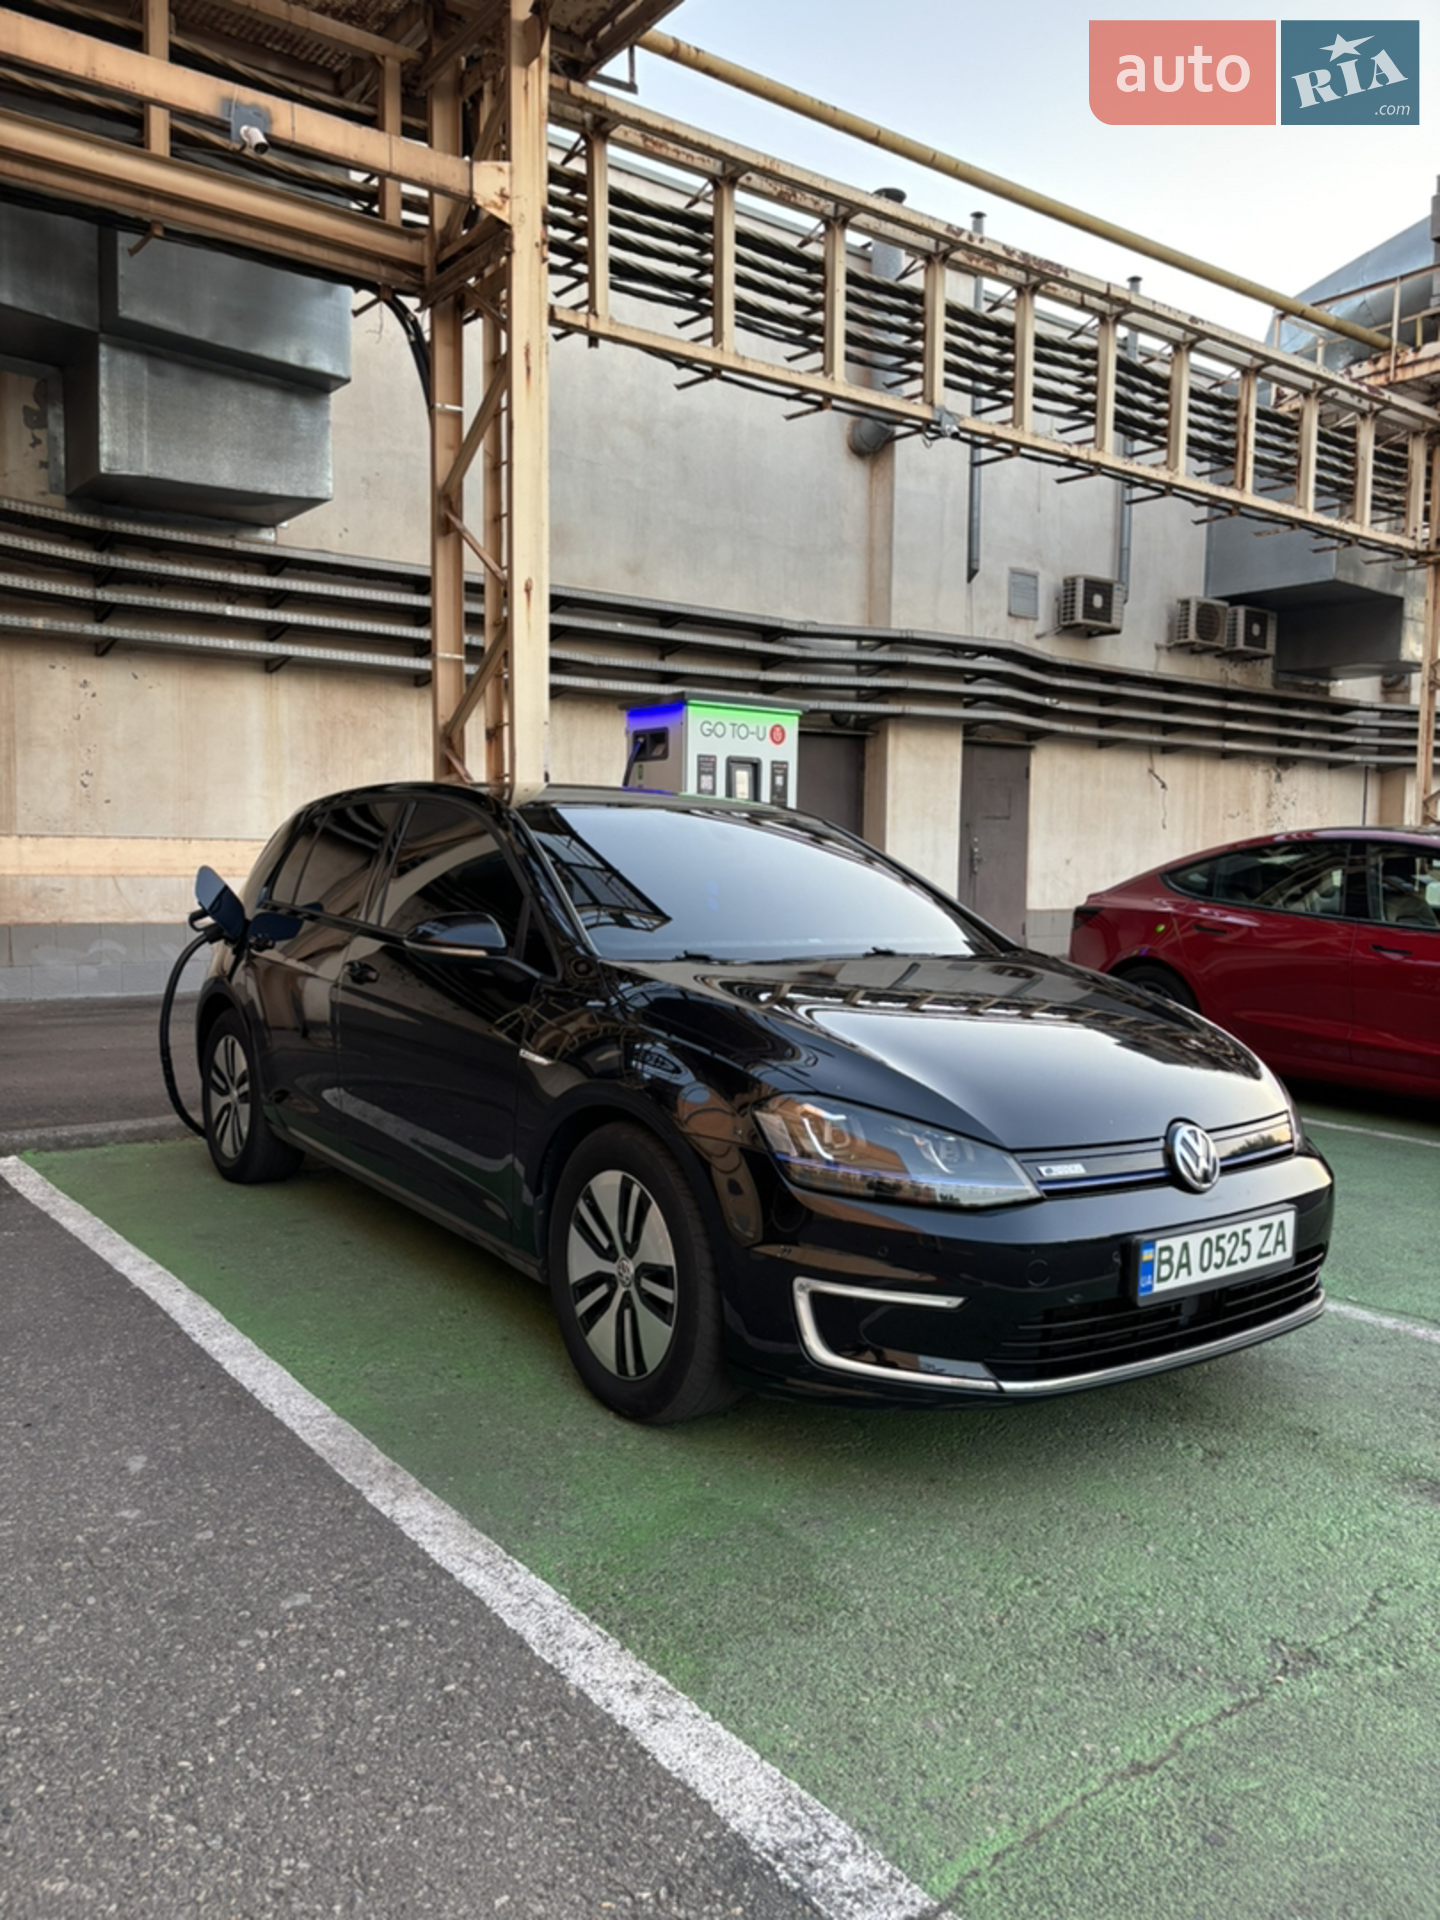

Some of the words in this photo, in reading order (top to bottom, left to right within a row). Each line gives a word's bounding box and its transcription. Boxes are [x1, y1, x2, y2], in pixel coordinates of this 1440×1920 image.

[700, 720, 726, 738] GO
[729, 722, 767, 742] TO-U
[1156, 1241, 1192, 1284] BA
[1199, 1227, 1252, 1273] 0525
[1257, 1219, 1288, 1260] ZA
